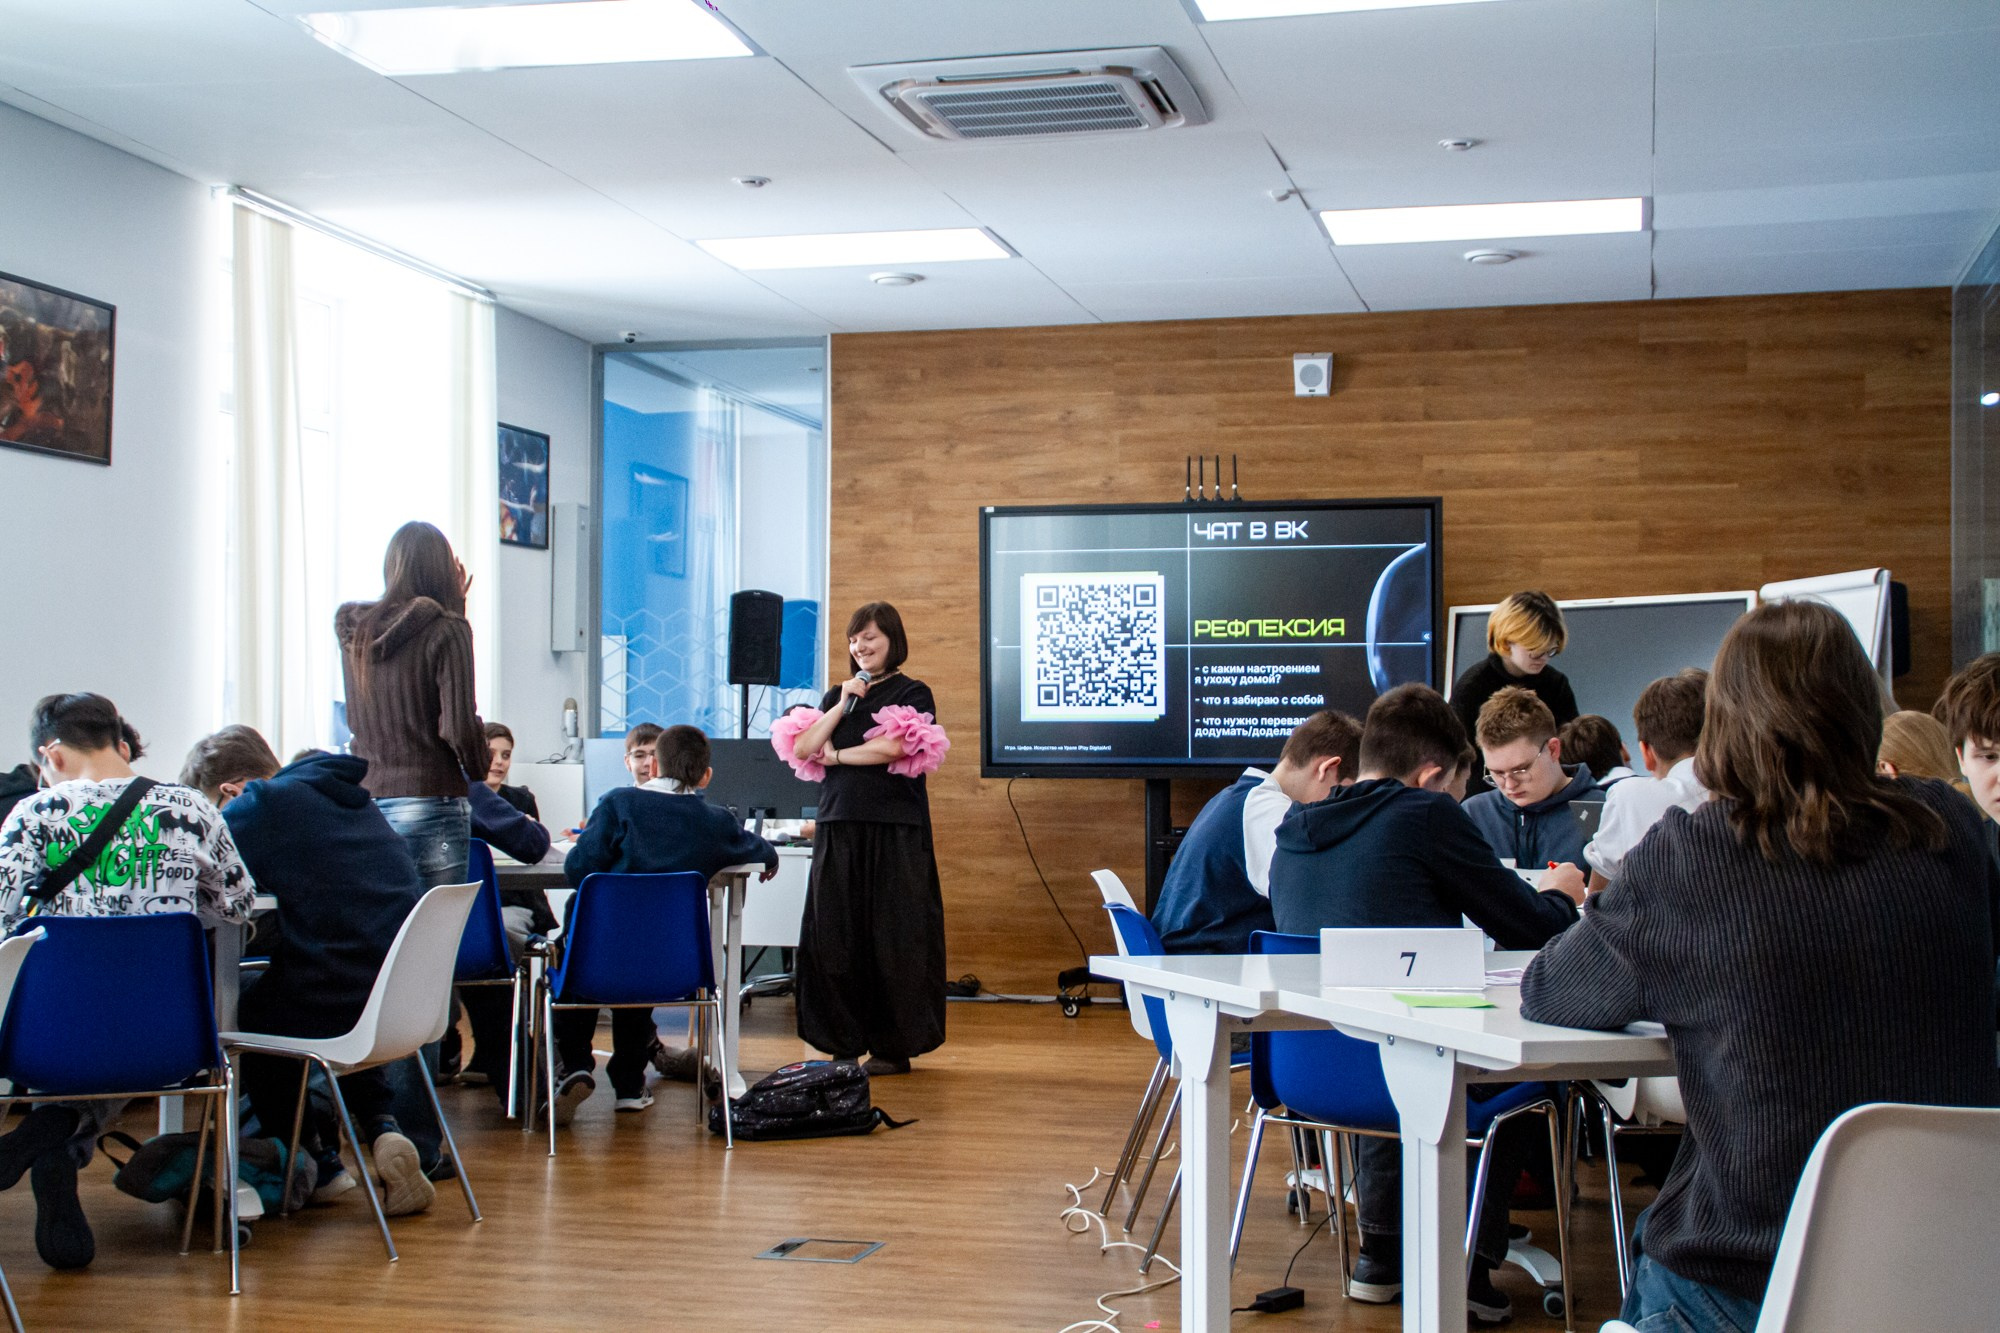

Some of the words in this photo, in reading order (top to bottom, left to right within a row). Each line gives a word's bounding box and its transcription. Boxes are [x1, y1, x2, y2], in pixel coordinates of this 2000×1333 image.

[1194, 521, 1243, 540] ЧАТ
[1249, 521, 1267, 540] В
[1274, 520, 1309, 539] ВК
[1194, 618, 1345, 638] РЕФЛЕКСИЯ
[1202, 665, 1209, 673] с
[1210, 665, 1245, 673] каким
[1246, 664, 1320, 675] настроением
[1194, 675, 1201, 684] я
[1203, 675, 1238, 686] ухожу
[1239, 673, 1282, 686] домой?
[1202, 696, 1221, 705] что
[1223, 696, 1230, 705] я
[1231, 694, 1280, 707] забираю
[1281, 696, 1289, 705] с
[1290, 694, 1325, 705] собой
[1202, 717, 1221, 726] что
[1223, 717, 1259, 728] нужно
[1260, 716, 1309, 728] перевар
[1194, 726, 1294, 738] додумать/додела
[1399, 951, 1417, 977] 7
